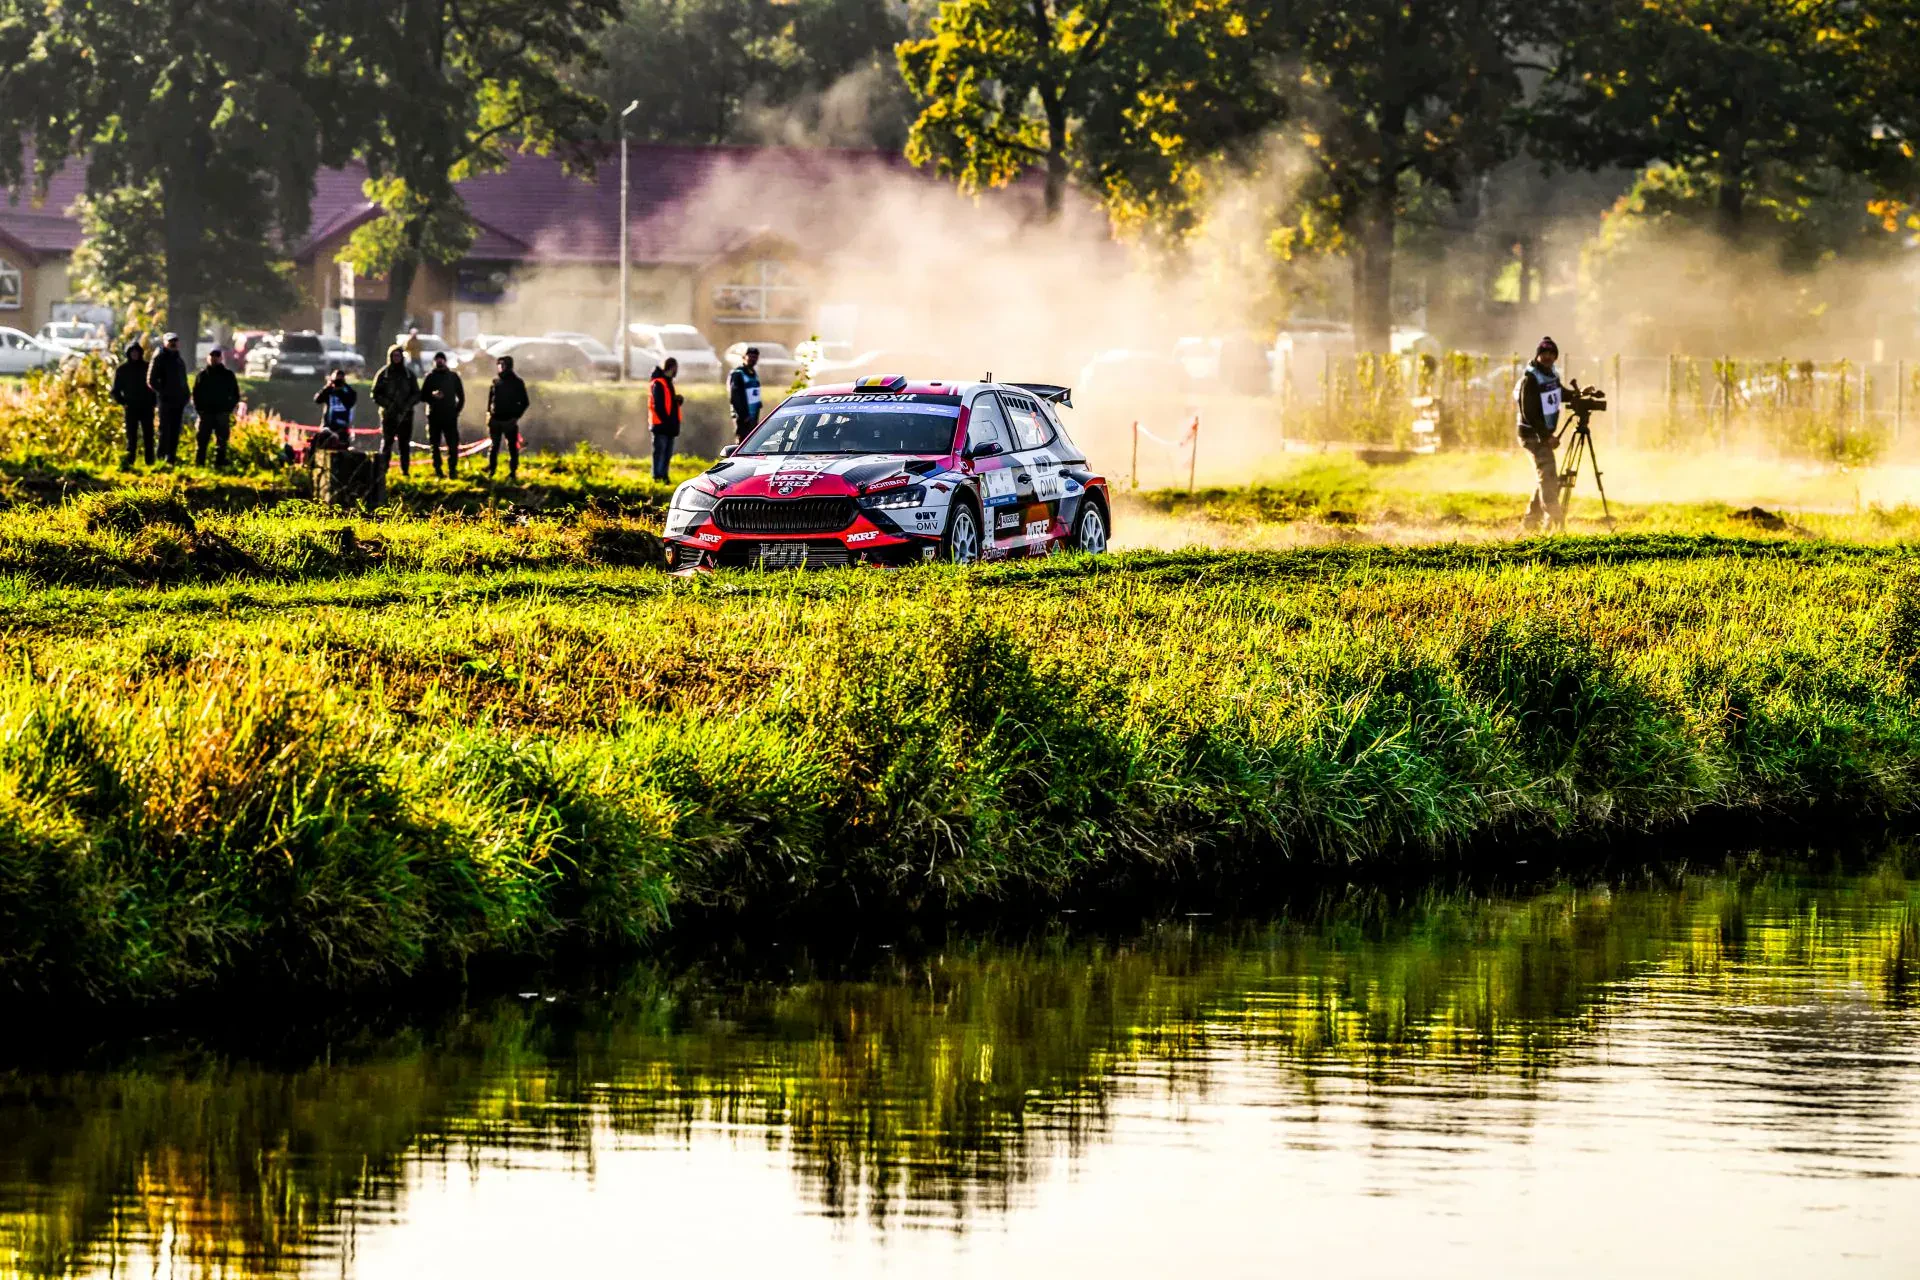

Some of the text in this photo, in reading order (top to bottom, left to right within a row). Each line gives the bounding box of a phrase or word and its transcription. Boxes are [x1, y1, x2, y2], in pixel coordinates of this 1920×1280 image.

[815, 393, 918, 404] Compexit
[1040, 477, 1058, 497] OMV
[916, 522, 938, 531] OMV
[1026, 519, 1050, 540] MRF
[699, 532, 722, 543] MRF
[846, 531, 879, 543] MRF
